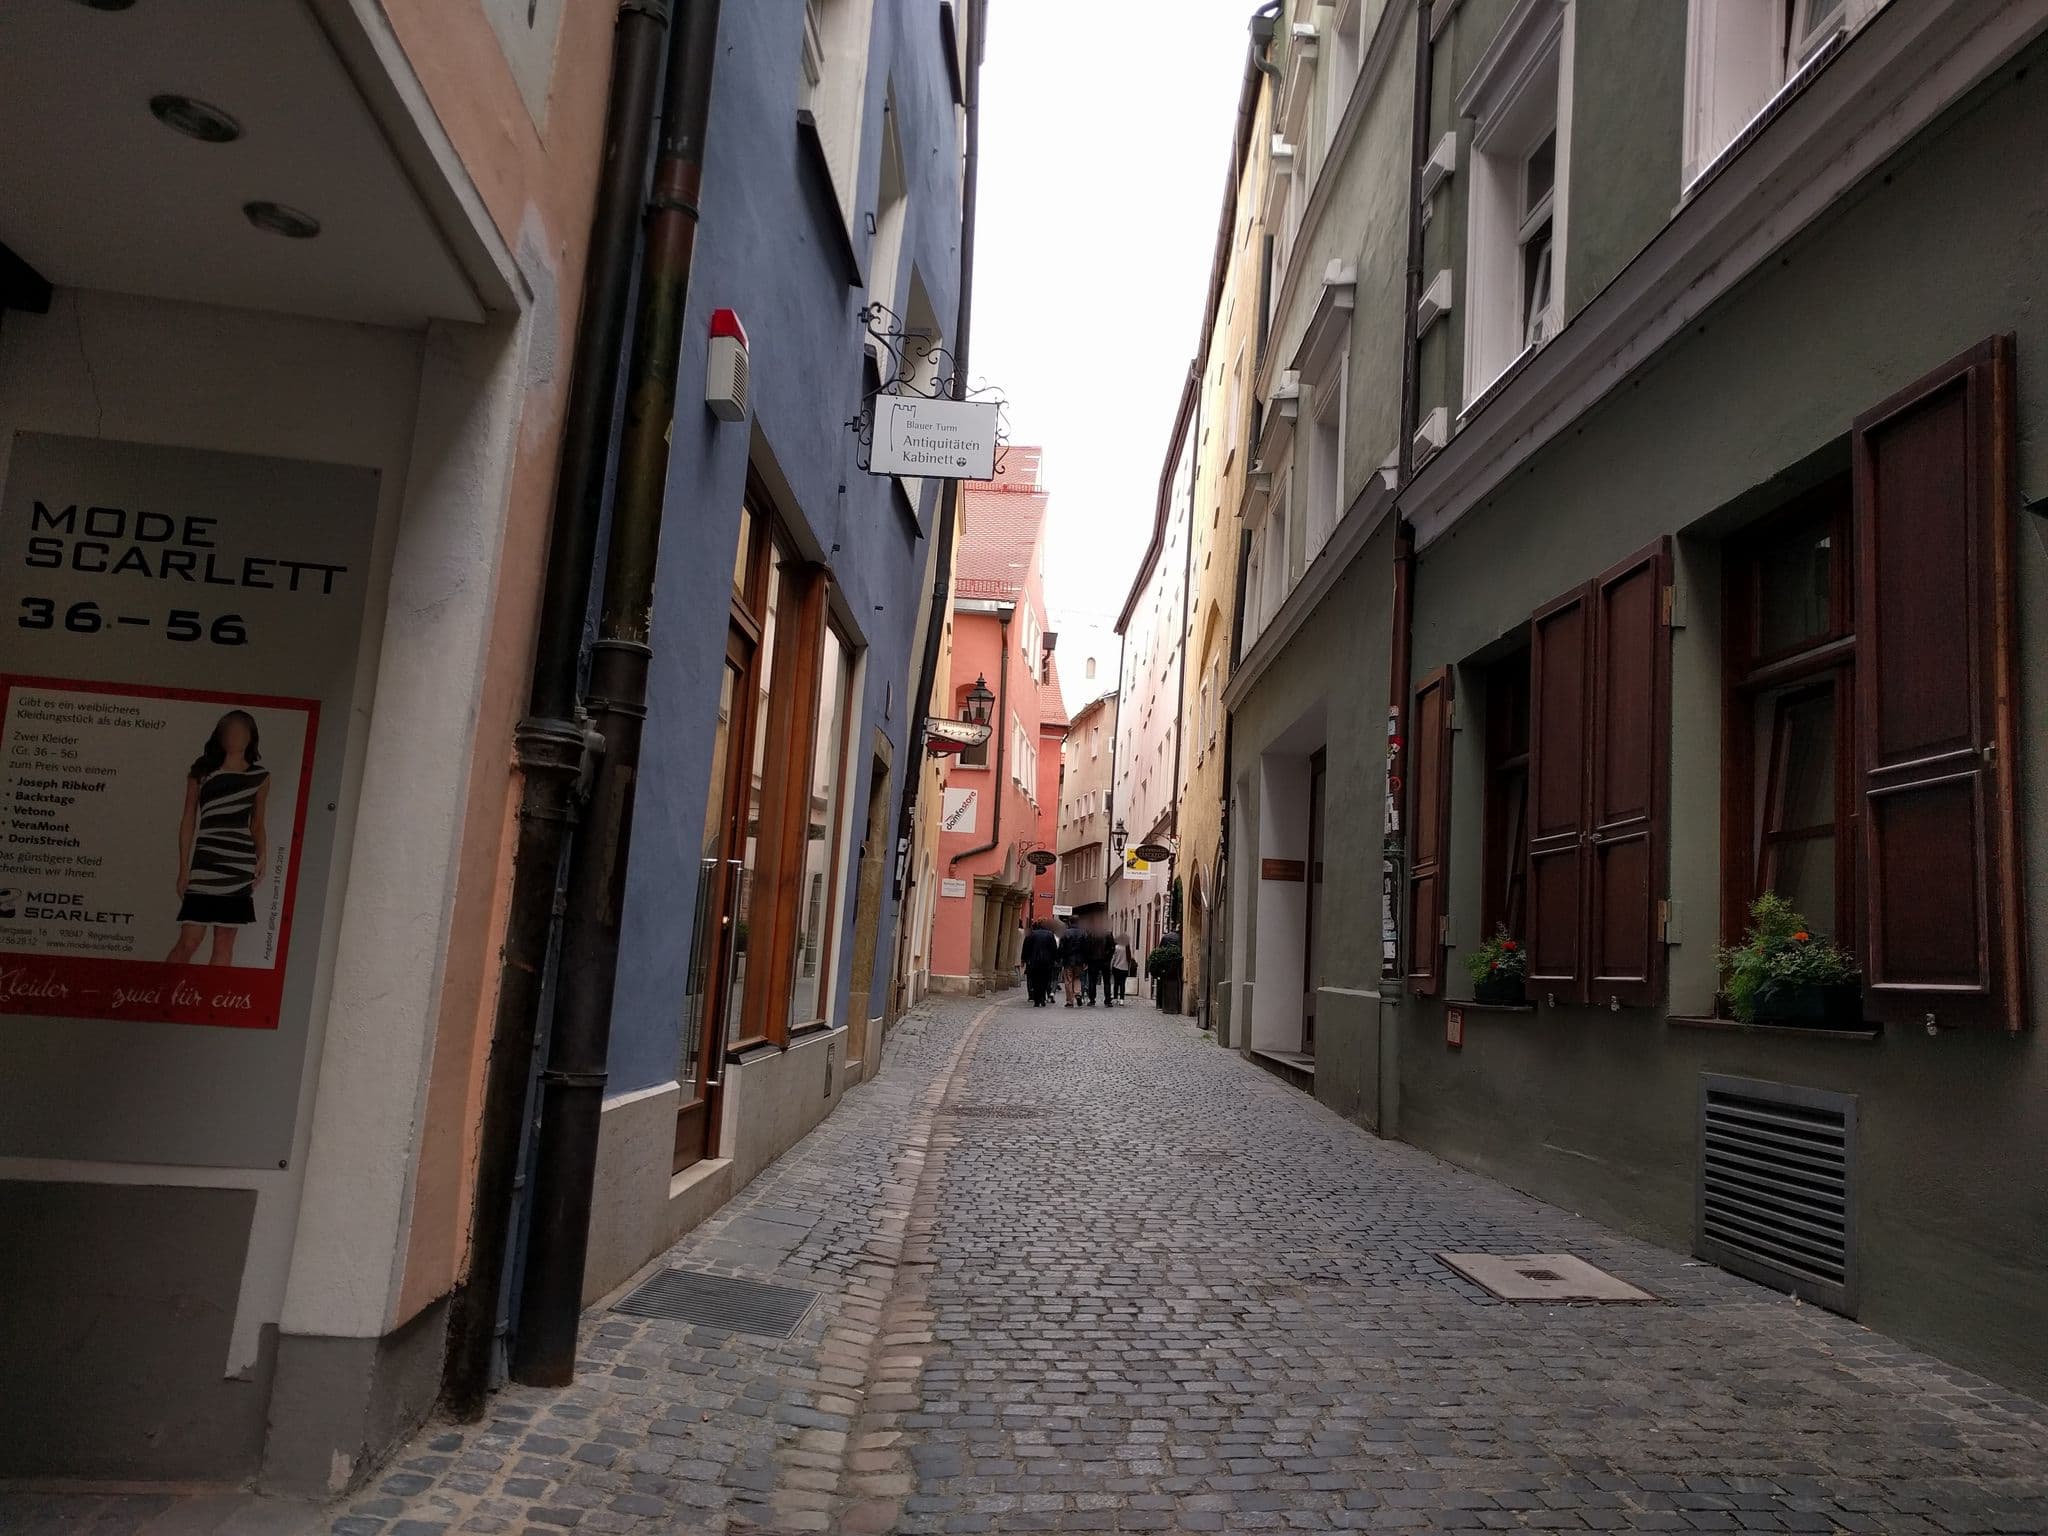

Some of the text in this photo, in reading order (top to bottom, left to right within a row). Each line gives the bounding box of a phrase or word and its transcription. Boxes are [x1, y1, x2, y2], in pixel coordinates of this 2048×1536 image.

[906, 420, 958, 432] Blauer Turm
[903, 435, 980, 451] Antiquitäten
[903, 451, 954, 465] Kabinett
[31, 501, 218, 547] MODE
[25, 537, 348, 594] SCARLETT
[18, 698, 141, 716] Gibt es ein weiblicheres
[16, 710, 167, 731] Kleidungsstück als das Kleid?
[14, 731, 79, 745] Zwei Kleider
[34, 747, 48, 757] 36
[60, 749, 78, 760] 56)
[9, 760, 117, 776] zum Preis von einem
[17, 778, 106, 793] Joseph Ribkoff
[15, 791, 76, 806] Backstage
[14, 805, 56, 818] Vetono
[11, 819, 71, 833] VeraMont
[8, 834, 80, 848] DorisStreich
[17, 852, 74, 866] günstigere
[76, 855, 103, 867] Kleid
[45, 867, 61, 876] wir
[27, 892, 85, 906] MODE
[24, 907, 135, 924] SCARLETT
[39, 928, 48, 937] 16
[111, 985, 162, 1009] zwei
[170, 979, 203, 1008] für
[211, 986, 254, 1009] eins
